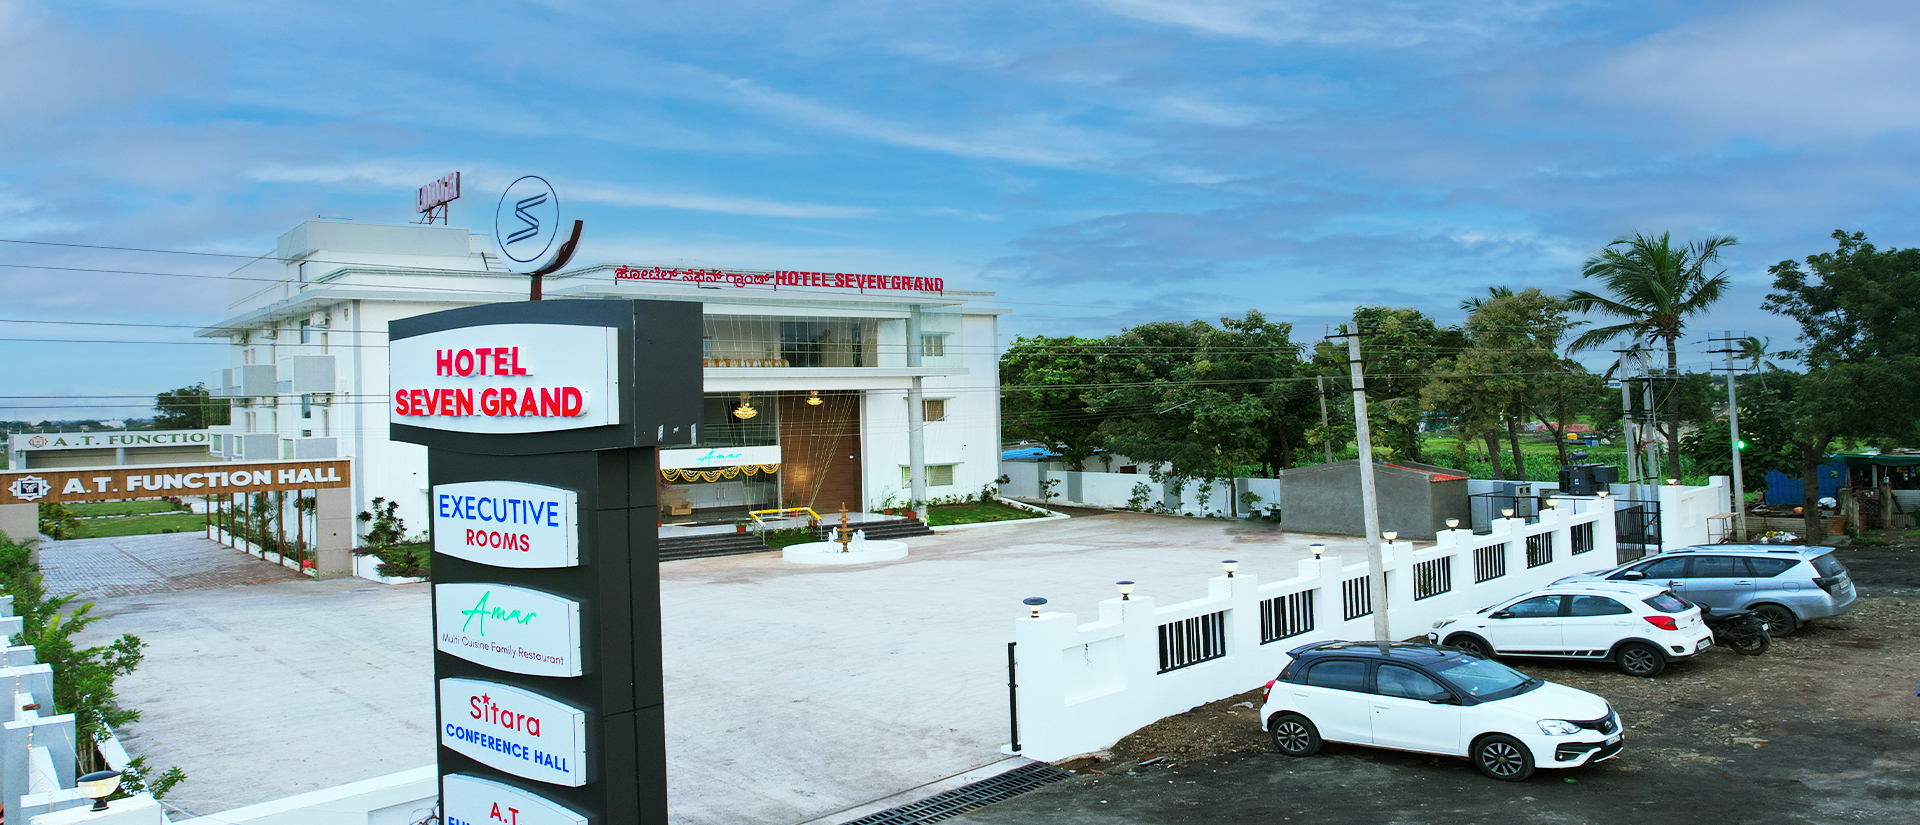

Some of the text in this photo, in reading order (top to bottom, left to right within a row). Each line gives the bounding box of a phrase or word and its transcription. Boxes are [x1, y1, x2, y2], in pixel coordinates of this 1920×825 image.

[415, 172, 455, 213] LODGE
[775, 270, 943, 292] HOTEL SEVEN GRAND
[436, 346, 527, 377] HOTEL
[395, 386, 583, 417] SEVEN GRAND
[108, 433, 210, 445] FUNCTIO
[61, 467, 342, 495] A.T. FUNCTION HALL
[439, 494, 559, 527] EXECUTIVE
[466, 528, 530, 552] ROOMS
[461, 590, 537, 637] Amar
[442, 633, 564, 666] Multi Cuisine Family Restaurant
[470, 692, 540, 737] Sitara
[446, 723, 570, 773] CONFERENCE HALL
